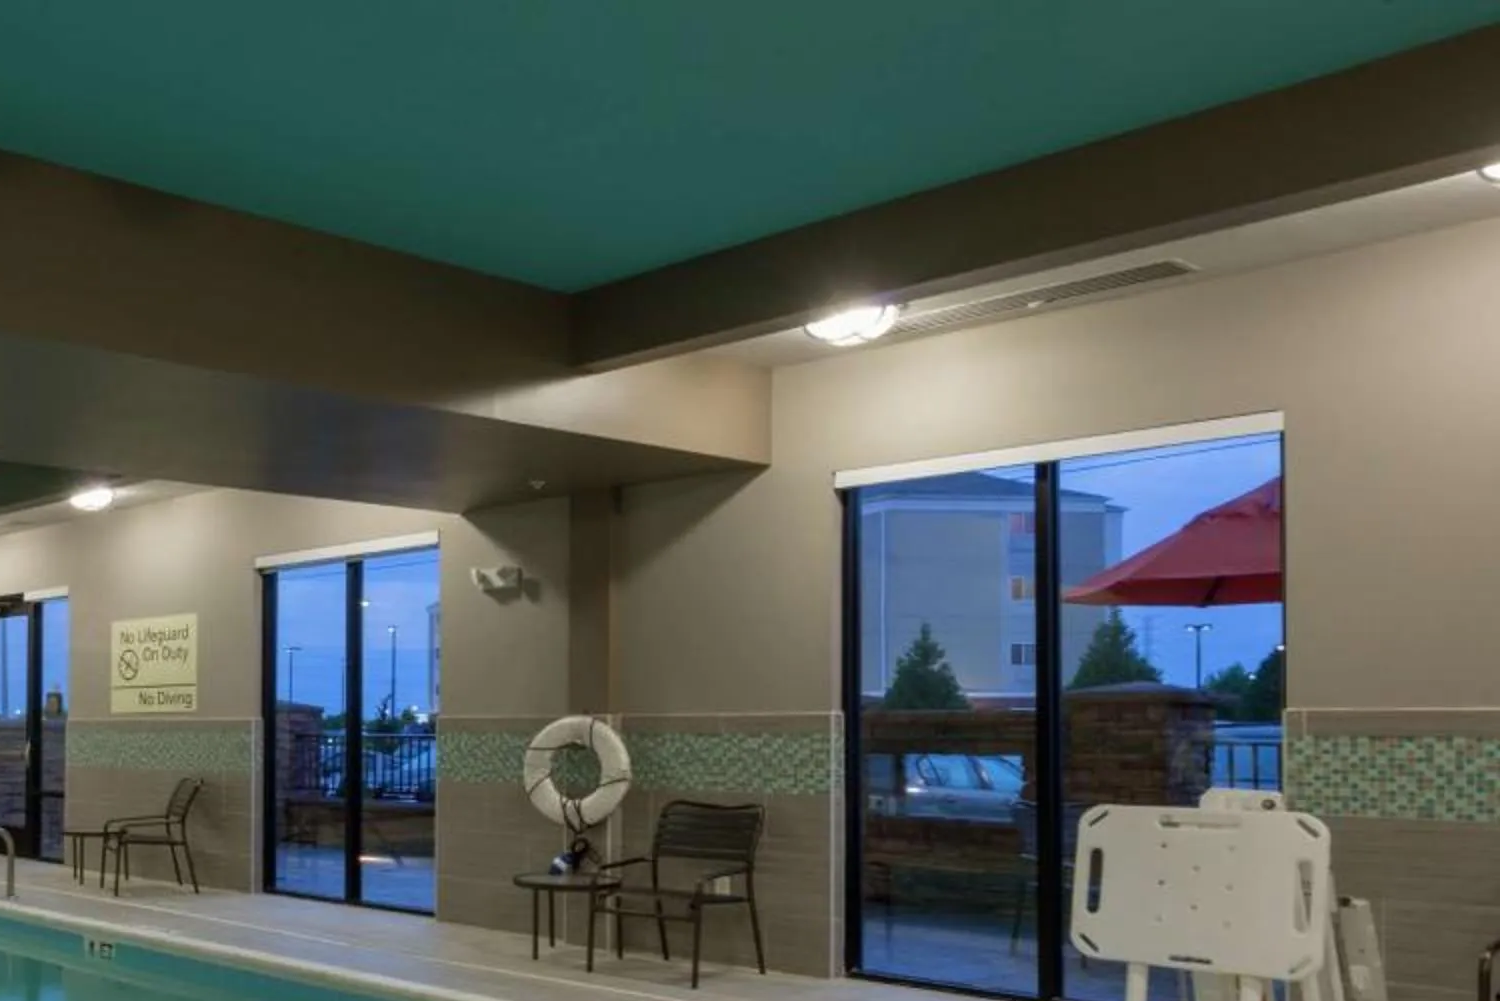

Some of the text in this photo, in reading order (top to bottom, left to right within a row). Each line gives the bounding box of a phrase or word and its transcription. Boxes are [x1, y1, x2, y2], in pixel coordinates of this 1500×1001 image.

[120, 623, 189, 647] No Lifeguard
[142, 646, 189, 664] On Duty
[138, 691, 192, 709] No Diving
